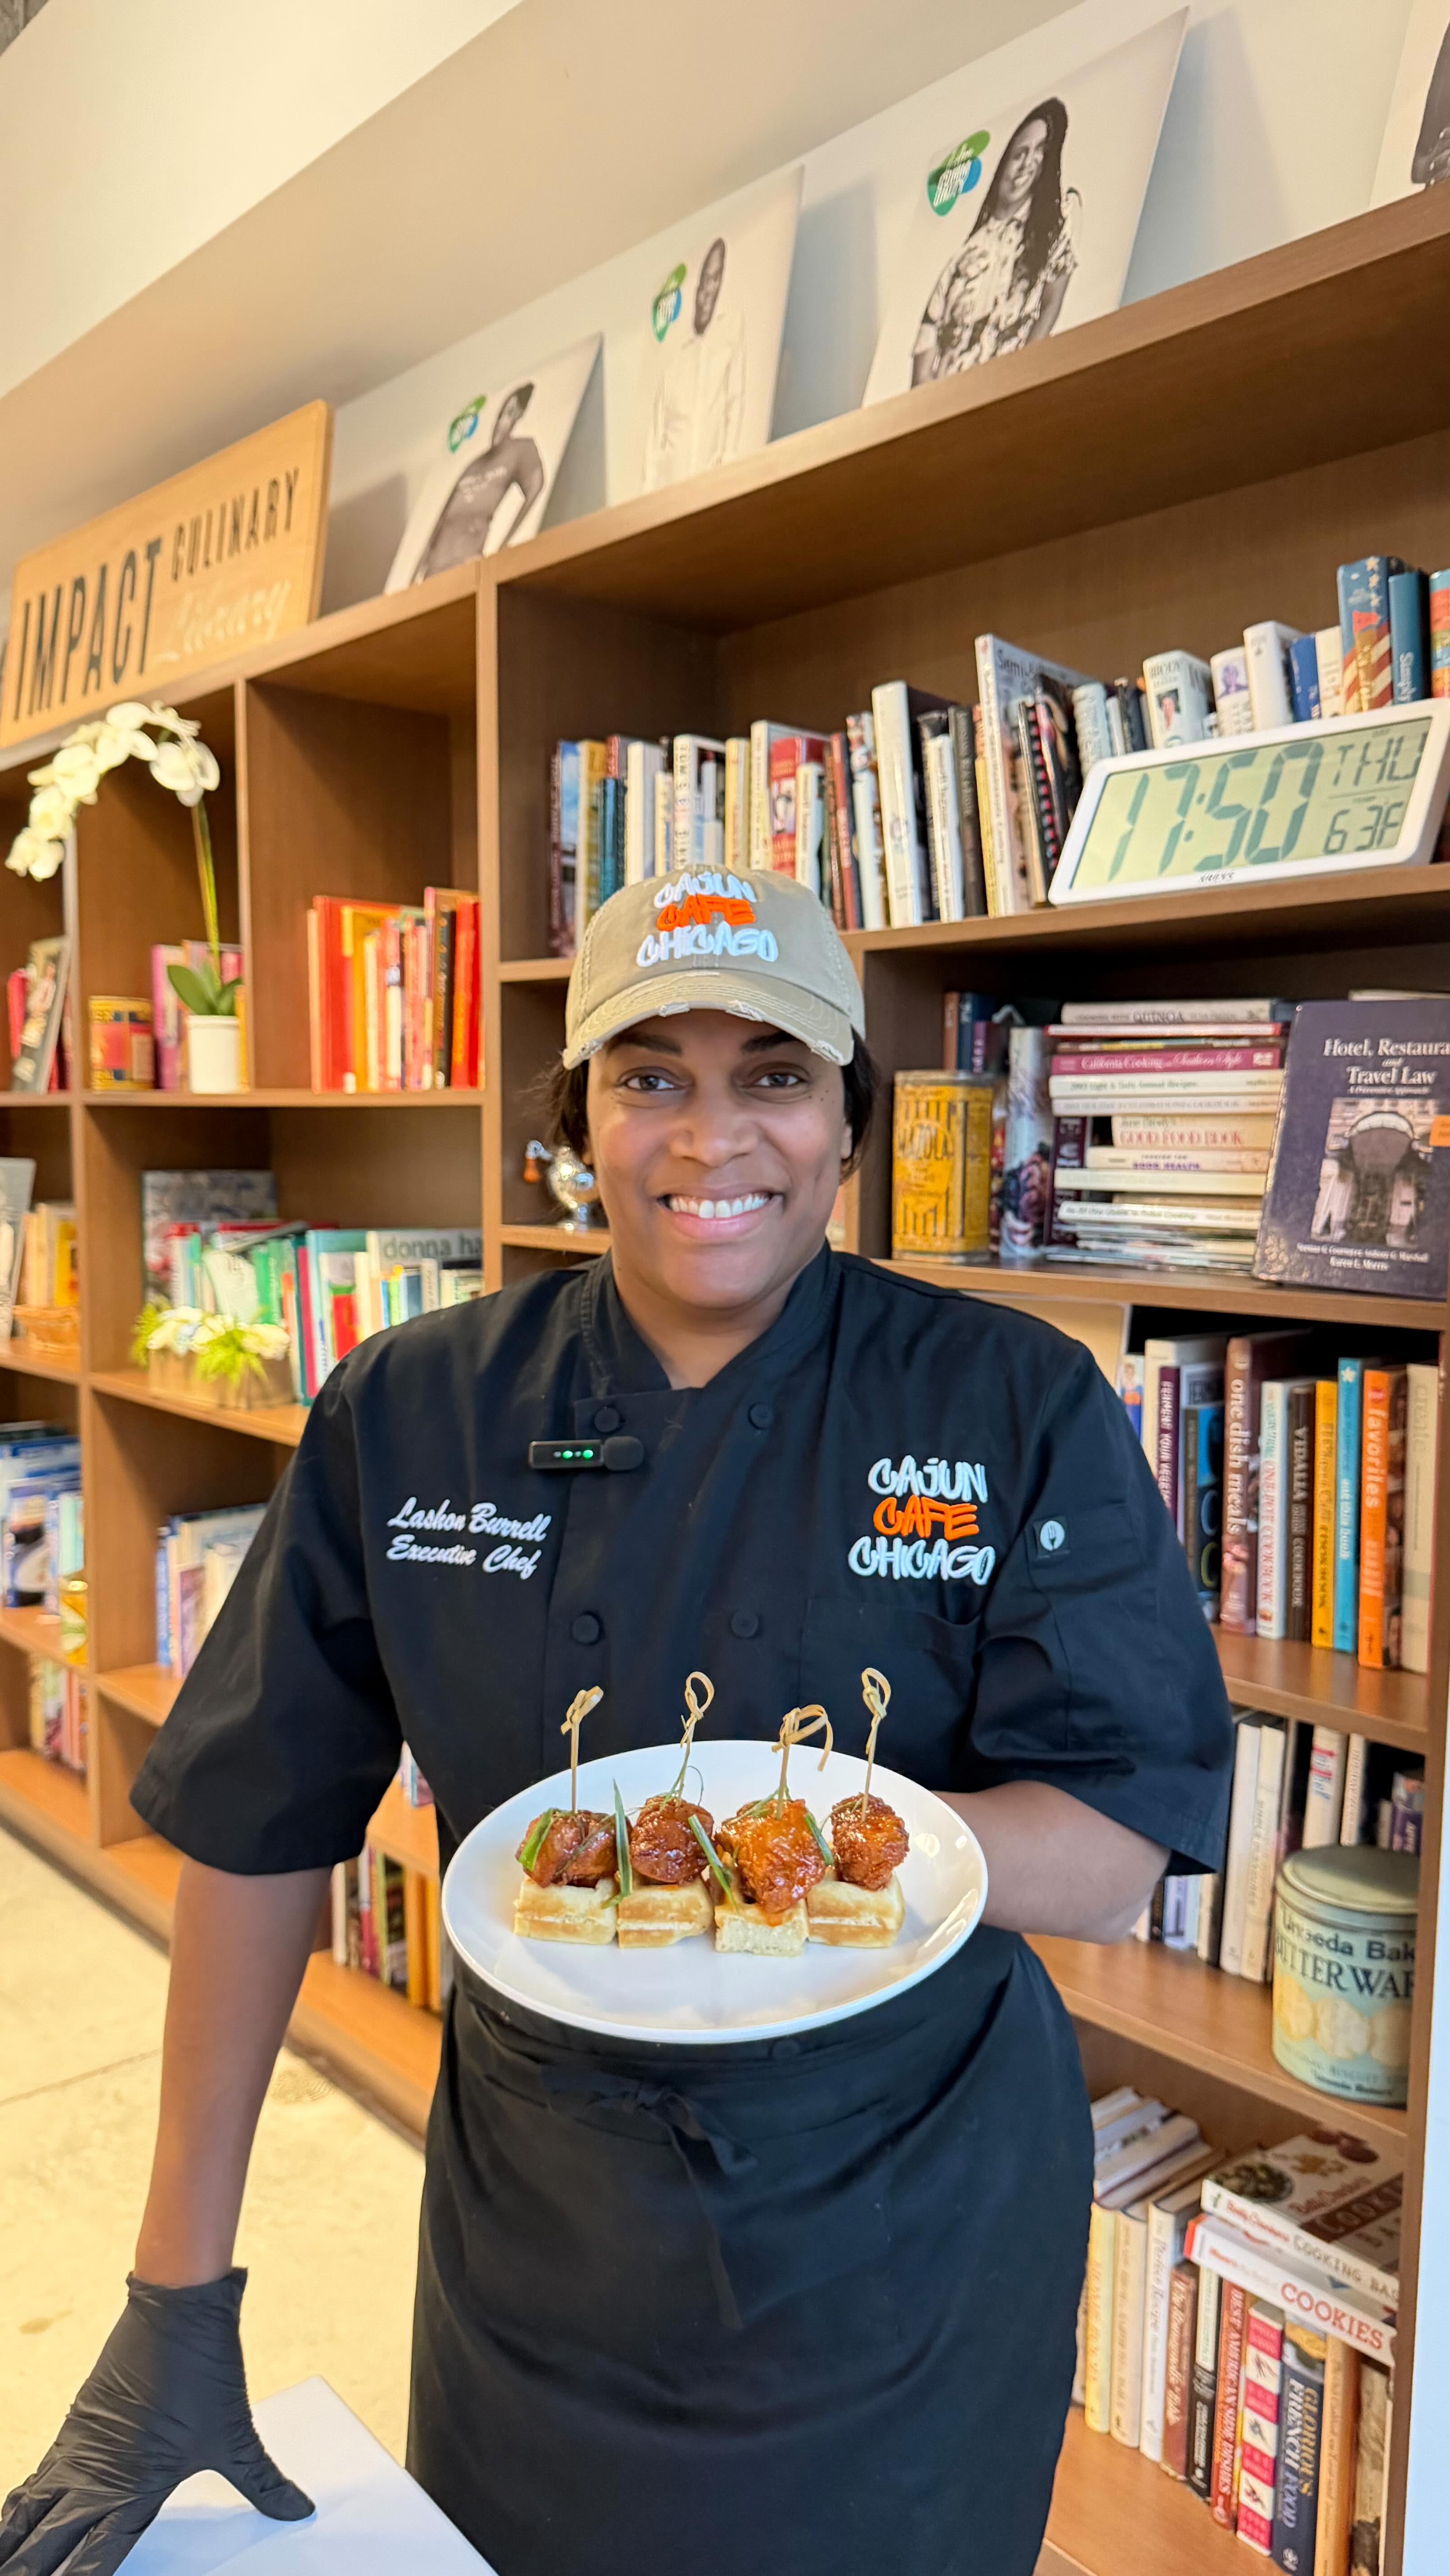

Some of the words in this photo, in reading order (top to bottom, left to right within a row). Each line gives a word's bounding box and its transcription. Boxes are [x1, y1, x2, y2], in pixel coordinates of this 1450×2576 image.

[170, 467, 299, 582] CULINARY
[14, 534, 164, 722] IMPACT
[1333, 731, 1428, 786] THU
[1108, 741, 1324, 882] 17:50
[654, 871, 757, 909] CAJUN
[656, 893, 756, 931] CAFE
[636, 922, 779, 967] CHICAGO
[1133, 1010, 1185, 1023] QUINOA
[1346, 1066, 1398, 1084] Travel
[1401, 1066, 1438, 1084] Law
[1120, 1131, 1156, 1144] GOOD
[1162, 1131, 1200, 1144] FOOD
[1204, 1131, 1243, 1145] BOOK
[384, 1237, 450, 1259] donna
[1230, 1379, 1246, 1419] one
[1229, 1422, 1251, 1468] dish
[1292, 1426, 1309, 1501] VIDALIA
[1365, 1408, 1389, 1509] favorites
[867, 1455, 988, 1503] CAJUN
[387, 1496, 466, 1532] Lashon
[468, 1502, 551, 1541] Burrell
[873, 1494, 979, 1541] CAFE
[1227, 1473, 1248, 1535] meals
[386, 1534, 477, 1566] Executive
[482, 1545, 541, 1579] Chef
[848, 1536, 996, 1585] CHICAGO
[1294, 2234, 1362, 2282] COOKING
[1280, 2282, 1383, 2351] COOKIES
[1225, 2331, 1241, 2405] AMERICAN
[1284, 2378, 1305, 2470] FRENCH
[1299, 2387, 1318, 2496] GLORIOUS
[1219, 2441, 1234, 2495] DISHES
[1282, 2473, 1299, 2529] FOOD
